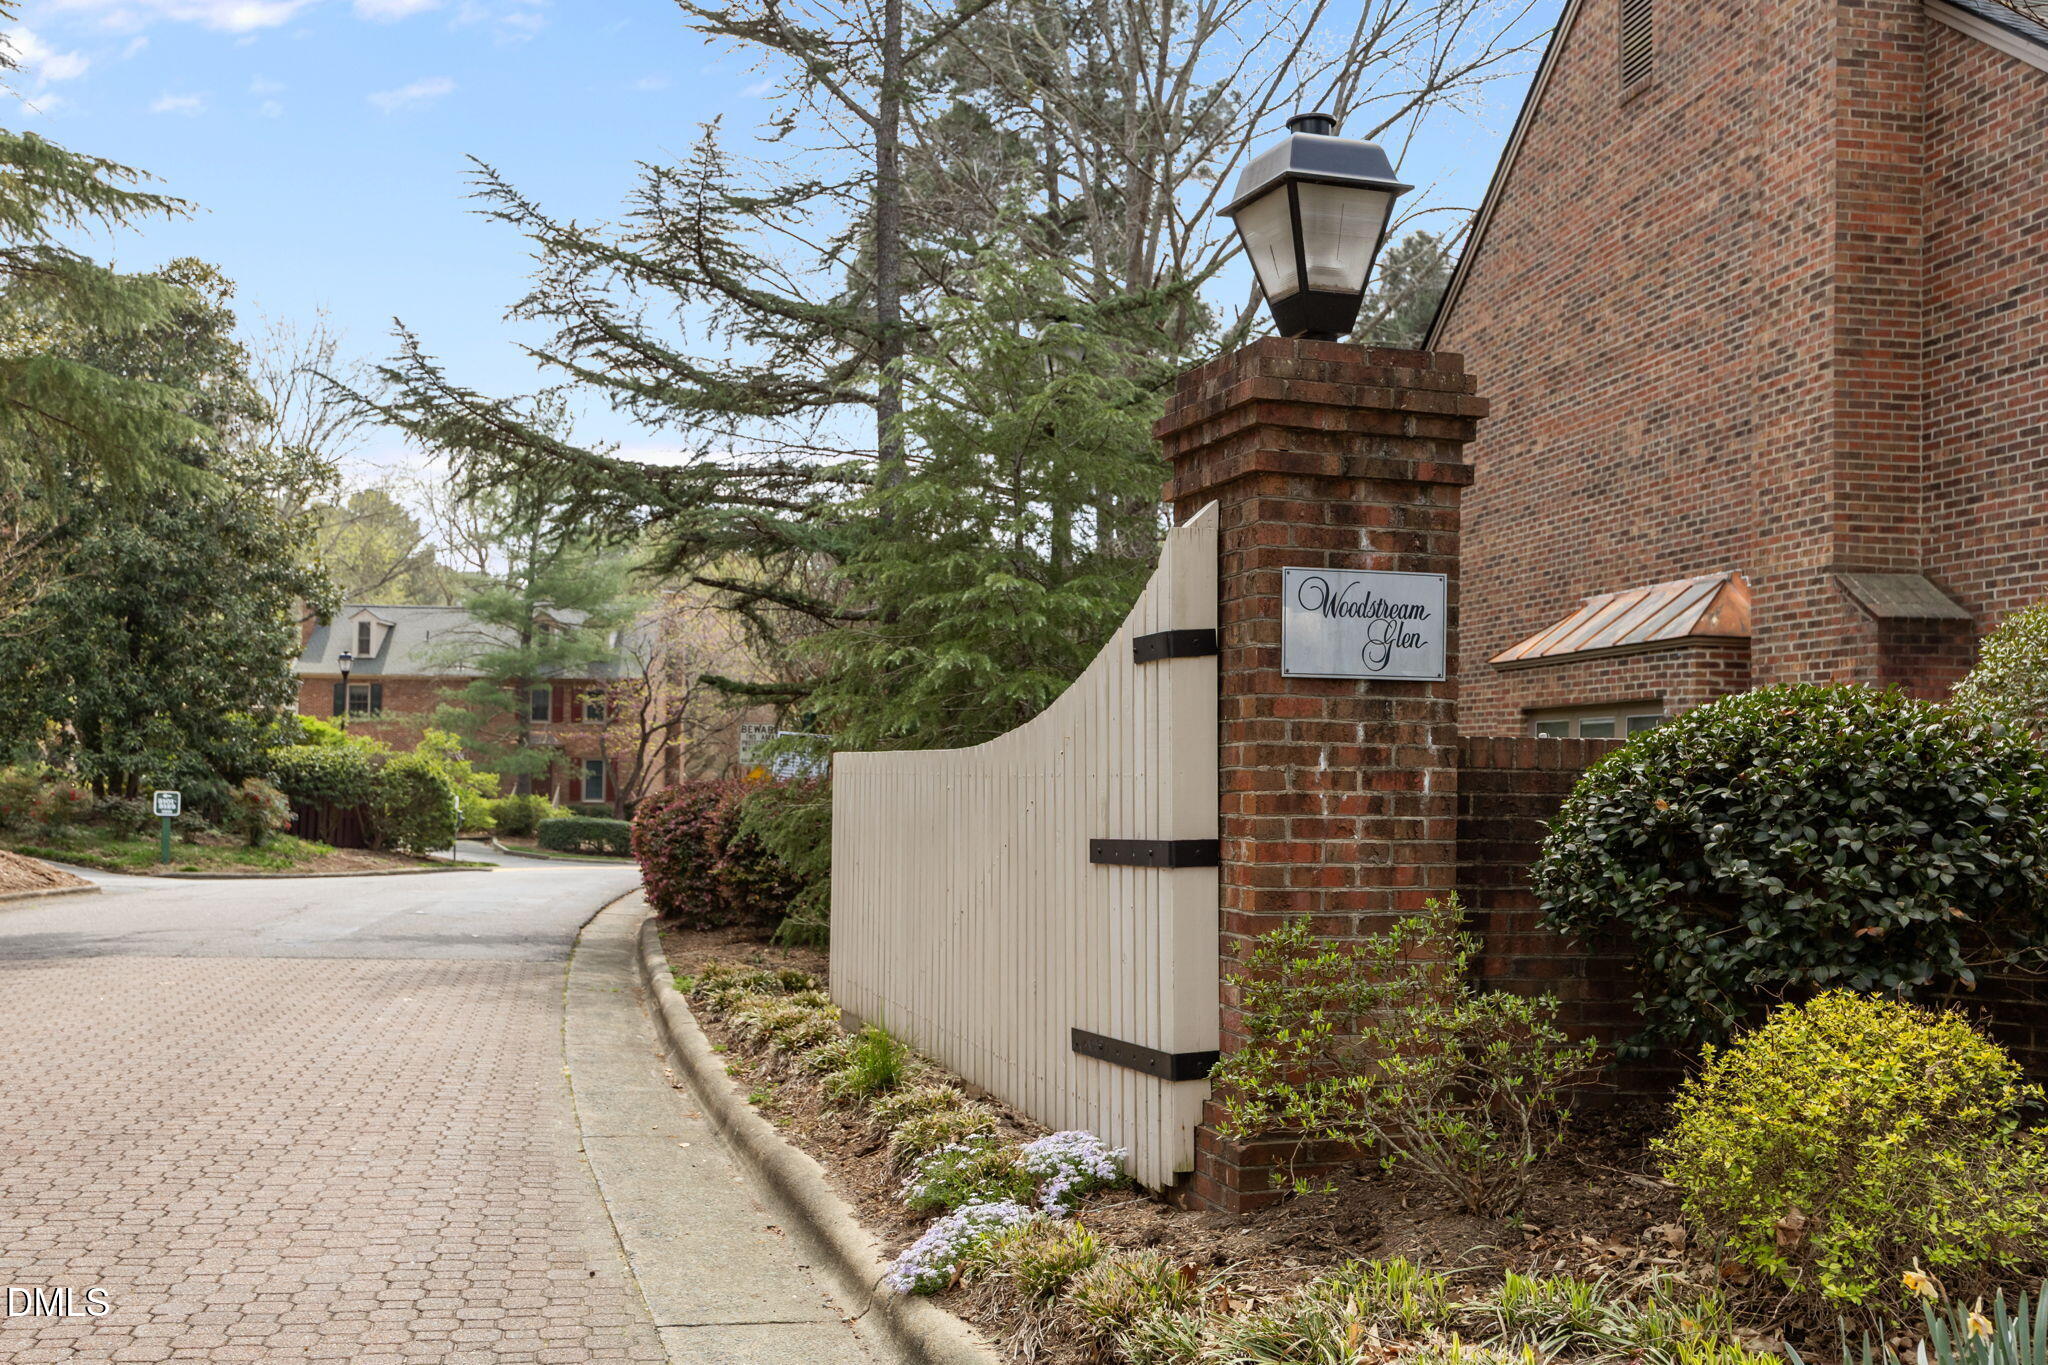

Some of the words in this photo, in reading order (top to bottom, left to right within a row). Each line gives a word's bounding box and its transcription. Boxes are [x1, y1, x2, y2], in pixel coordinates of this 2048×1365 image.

[1298, 576, 1431, 621] Woodstream
[1362, 618, 1428, 672] Glen
[741, 725, 778, 734] BEWAR
